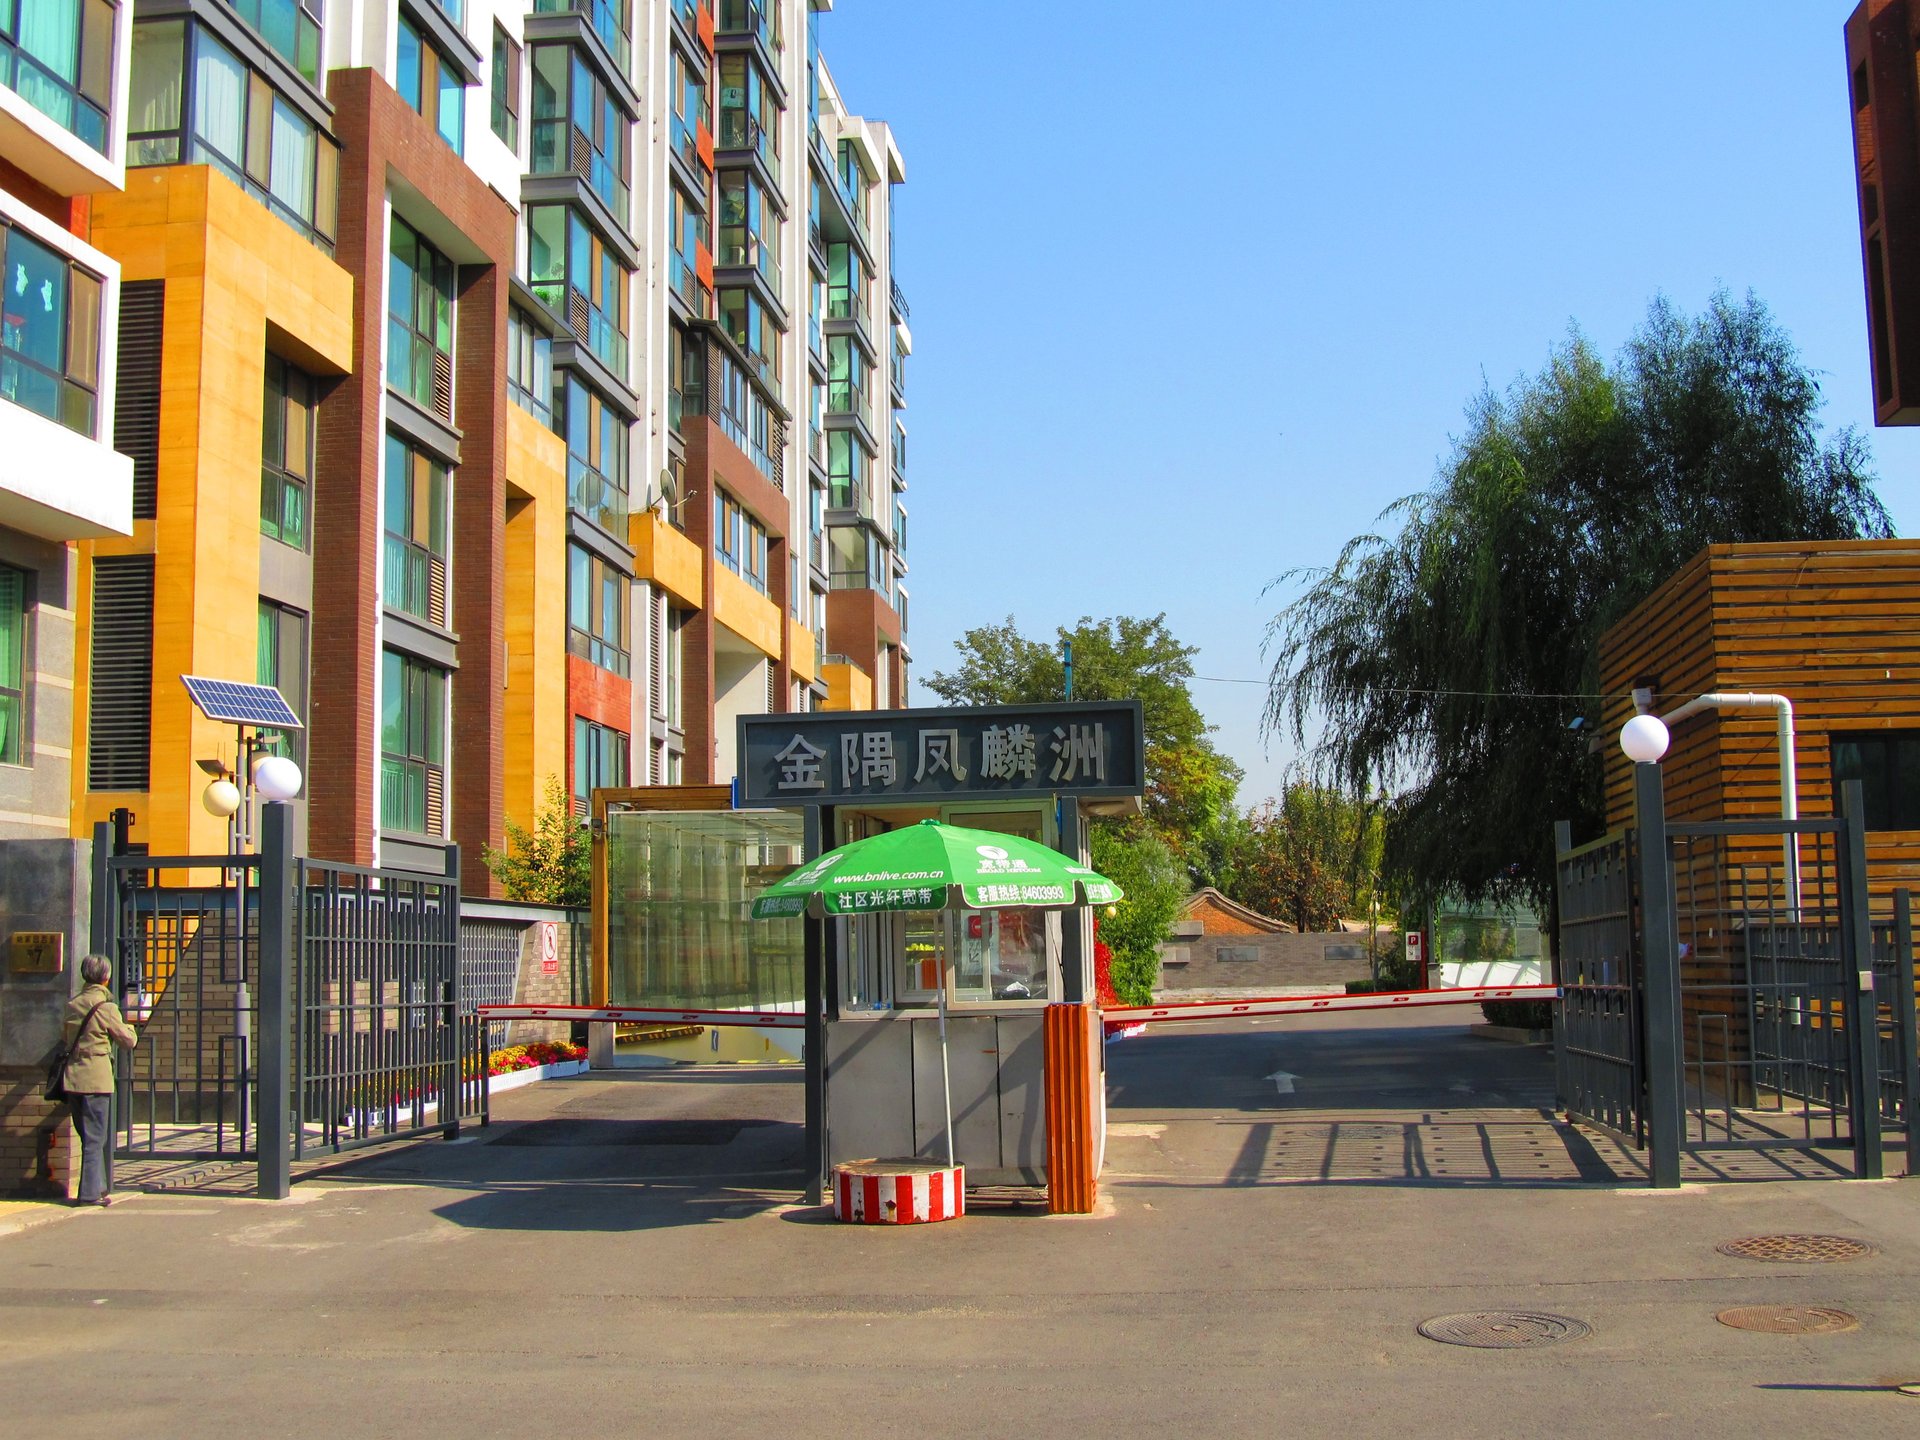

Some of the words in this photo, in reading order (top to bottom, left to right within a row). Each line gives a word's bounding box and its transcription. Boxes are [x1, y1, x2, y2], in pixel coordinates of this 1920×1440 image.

[774, 722, 1105, 790] 金隅凤麟洲
[833, 870, 944, 884] www.bnlive.com.cn
[839, 887, 932, 909] 社区光纤宽带
